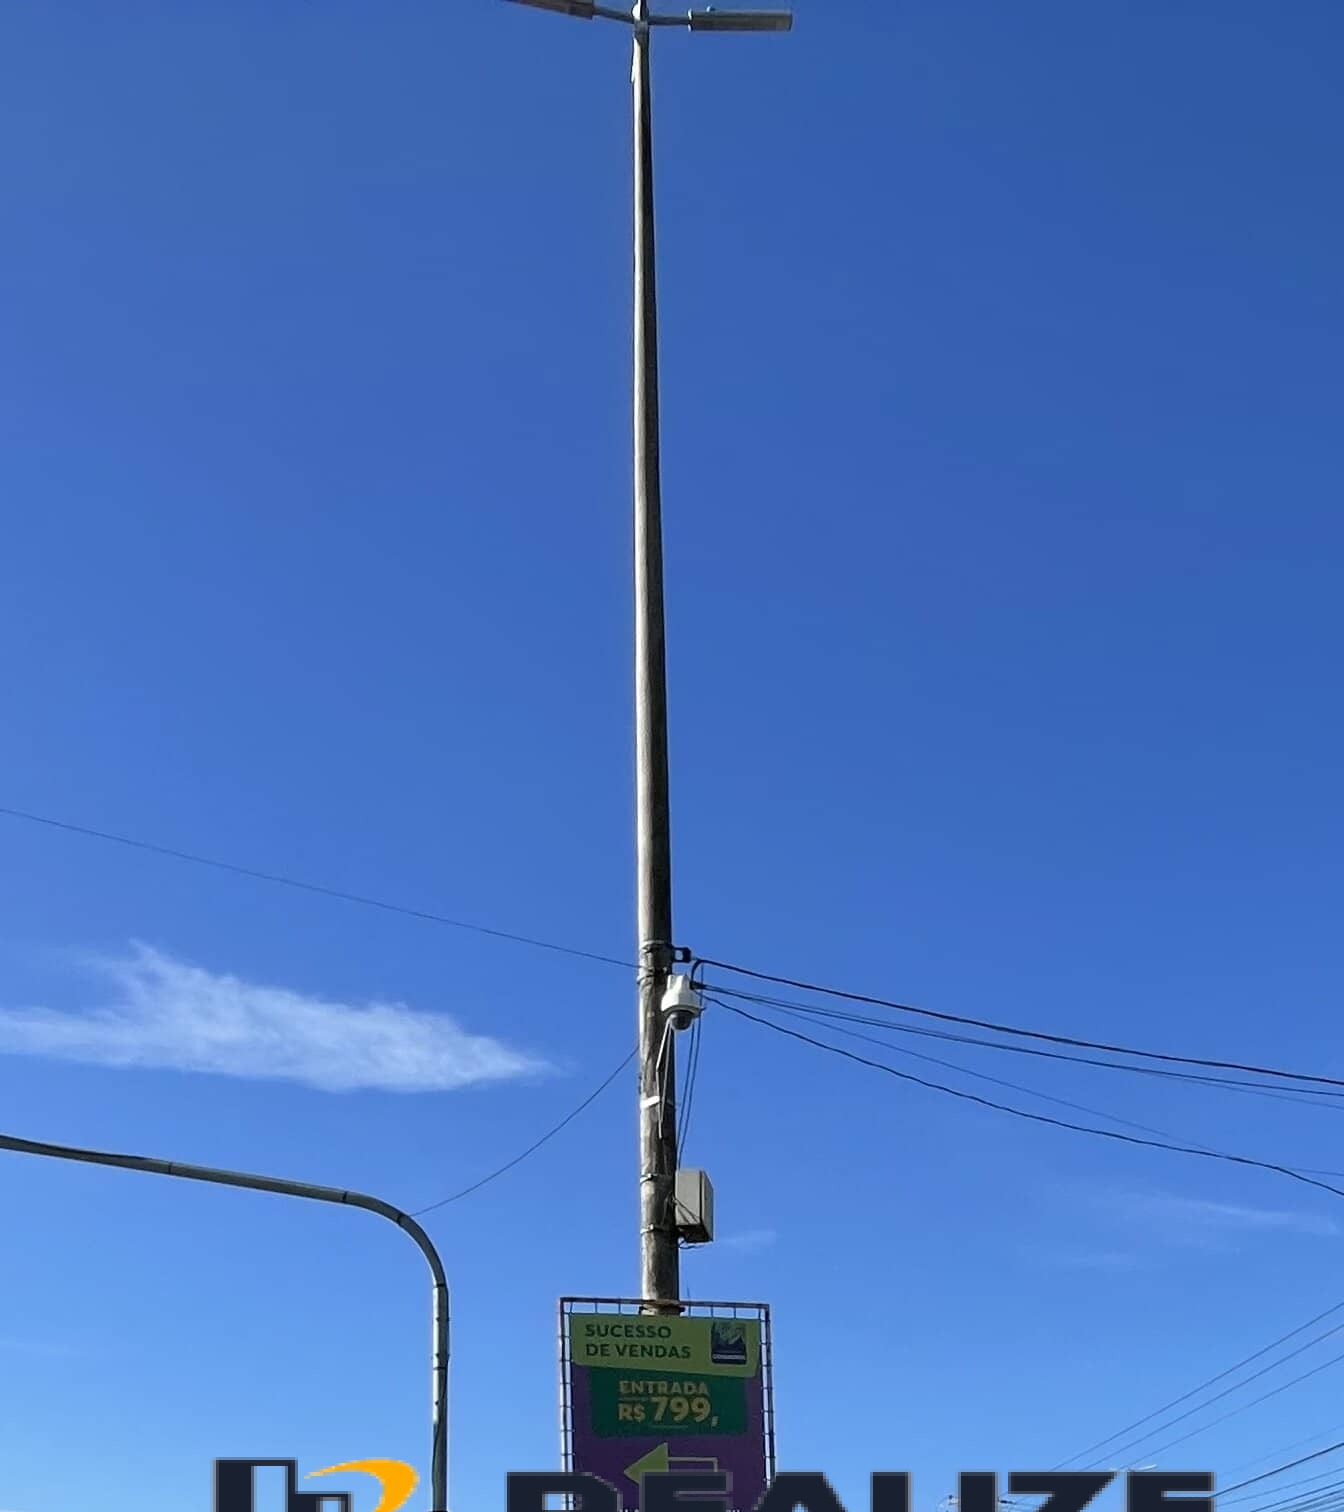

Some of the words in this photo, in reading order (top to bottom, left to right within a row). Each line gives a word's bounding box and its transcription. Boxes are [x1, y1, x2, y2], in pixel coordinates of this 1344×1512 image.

[584, 1323, 672, 1339] SUCESSO
[585, 1343, 610, 1358] DE
[615, 1344, 692, 1359] VENDAS
[618, 1379, 711, 1395] ENTRADA
[617, 1402, 646, 1423] R$
